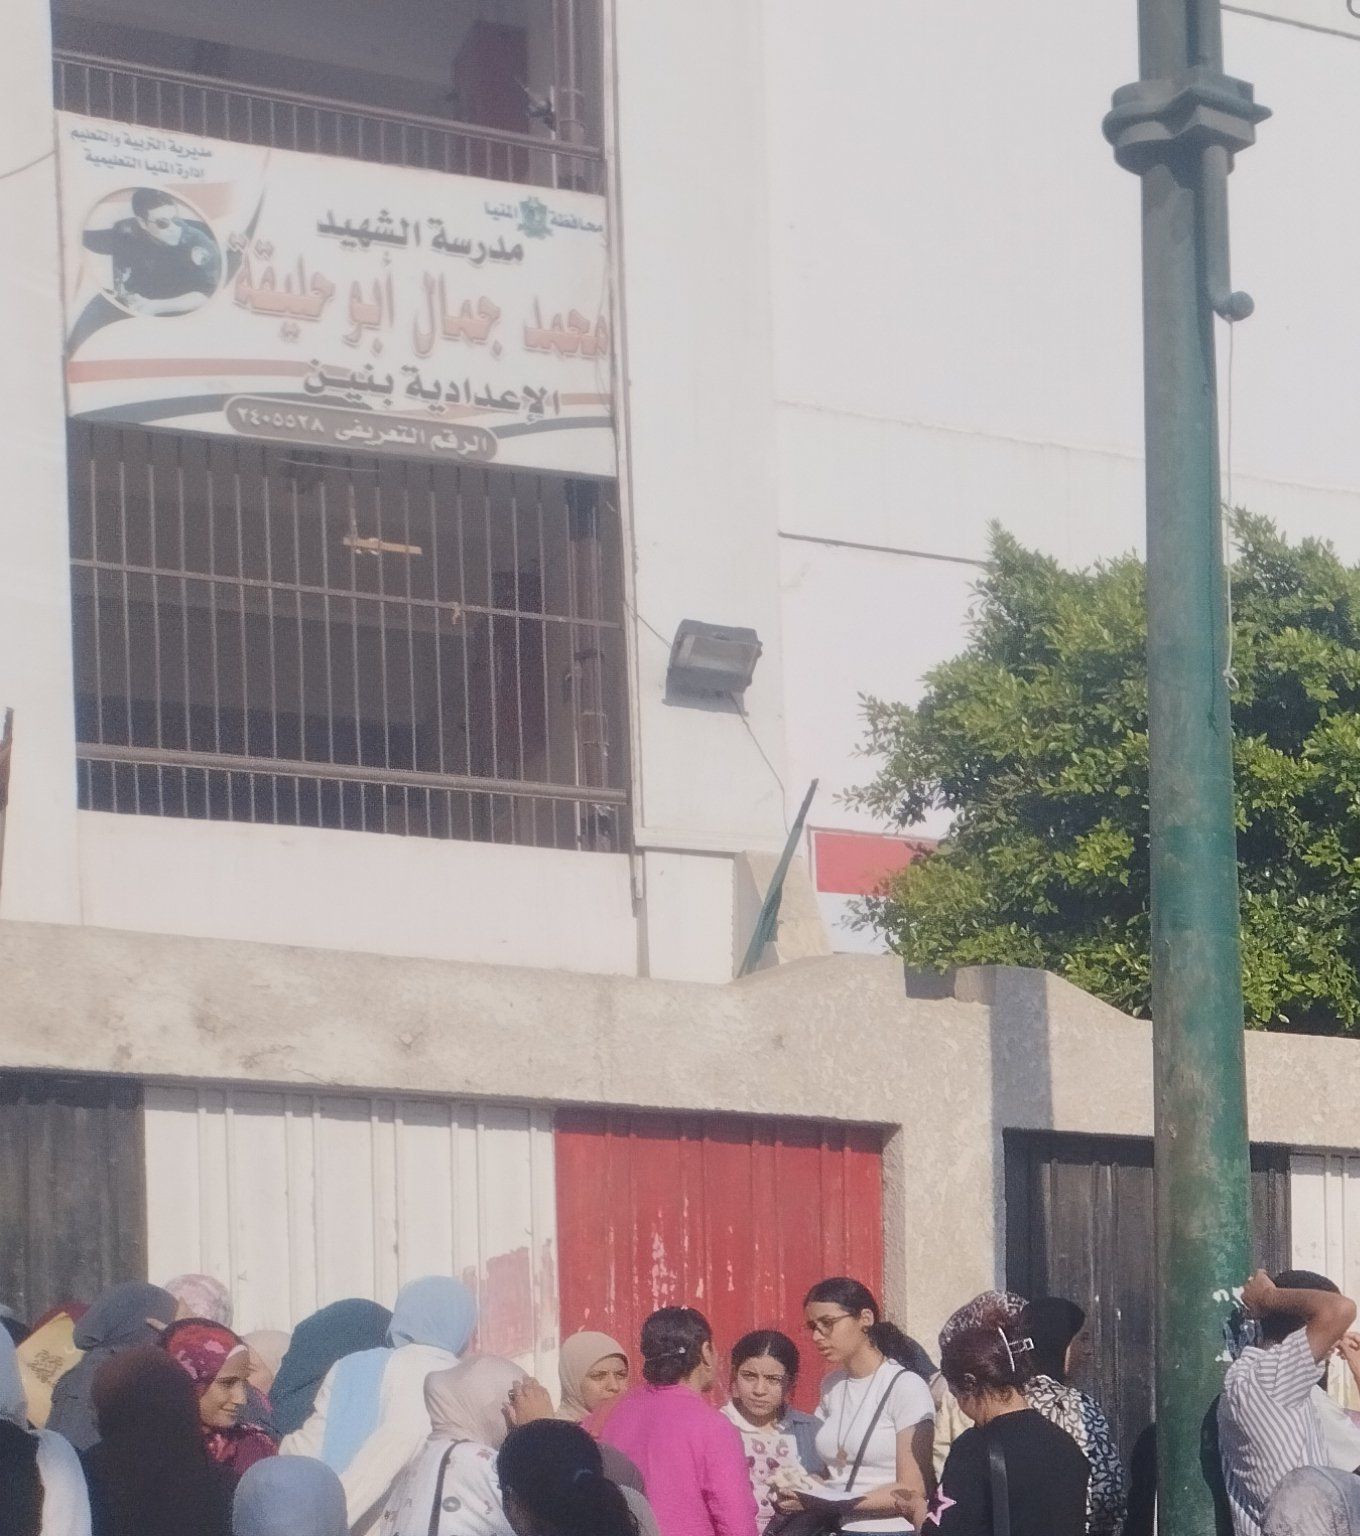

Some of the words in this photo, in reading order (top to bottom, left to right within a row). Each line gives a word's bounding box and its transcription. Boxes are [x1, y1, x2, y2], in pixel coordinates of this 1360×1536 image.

[70, 127, 121, 147] والتعليم
[123, 132, 166, 151] التربية
[168, 138, 213, 160] مديرية
[84, 147, 143, 169] التعليمية
[144, 160, 174, 176] المنيا
[483, 201, 519, 221] المنيا
[549, 209, 604, 233] محافظة
[316, 208, 421, 248] الشهيد
[427, 216, 525, 265] مدرسة
[413, 271, 503, 360] جمال
[523, 297, 609, 358] محمد
[303, 358, 394, 405] بنين
[400, 364, 561, 425] الإعدادية
[430, 428, 488, 455] الرقم
